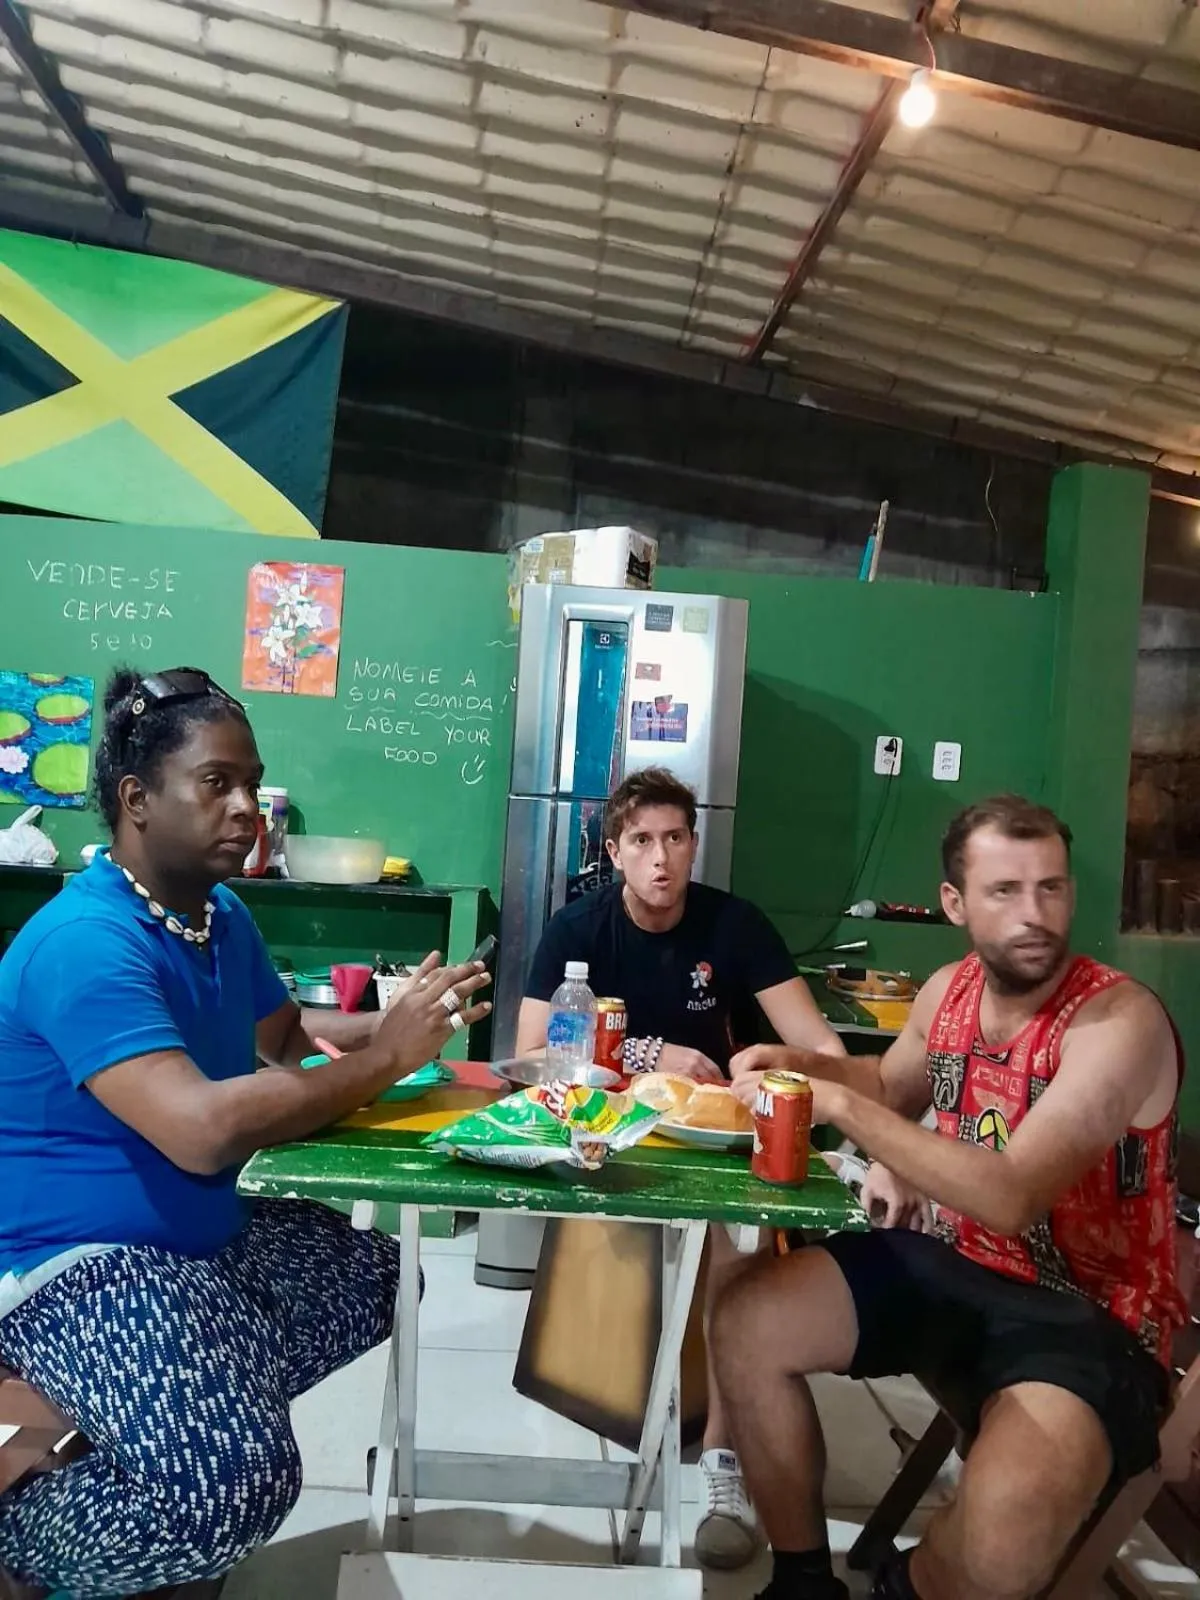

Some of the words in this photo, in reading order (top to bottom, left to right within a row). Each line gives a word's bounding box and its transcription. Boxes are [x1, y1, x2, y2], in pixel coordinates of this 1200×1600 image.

[353, 657, 442, 684] NOMEIE
[460, 668, 477, 688] A
[349, 686, 396, 702] SUA
[346, 714, 420, 736] LABEL
[444, 724, 491, 746] YOUR
[384, 746, 438, 765] FOOD
